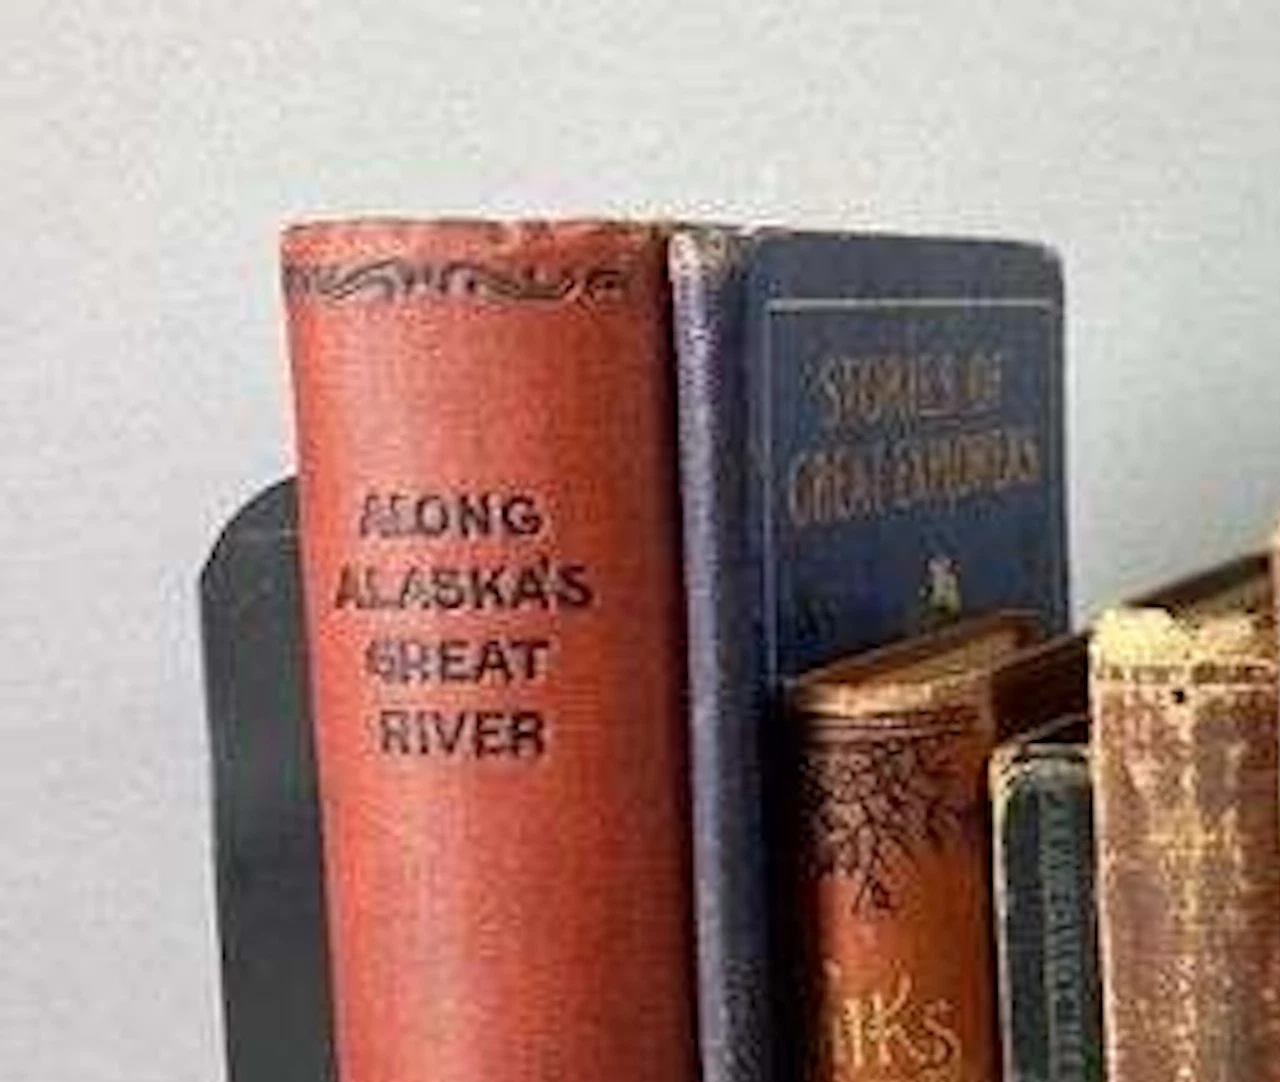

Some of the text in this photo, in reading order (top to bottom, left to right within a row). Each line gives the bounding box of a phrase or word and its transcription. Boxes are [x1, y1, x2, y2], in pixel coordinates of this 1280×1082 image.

[360, 493, 543, 538] ALONG
[335, 556, 595, 611] ALASKA'S
[364, 638, 549, 684] GREAT
[380, 709, 547, 759] RIVER
